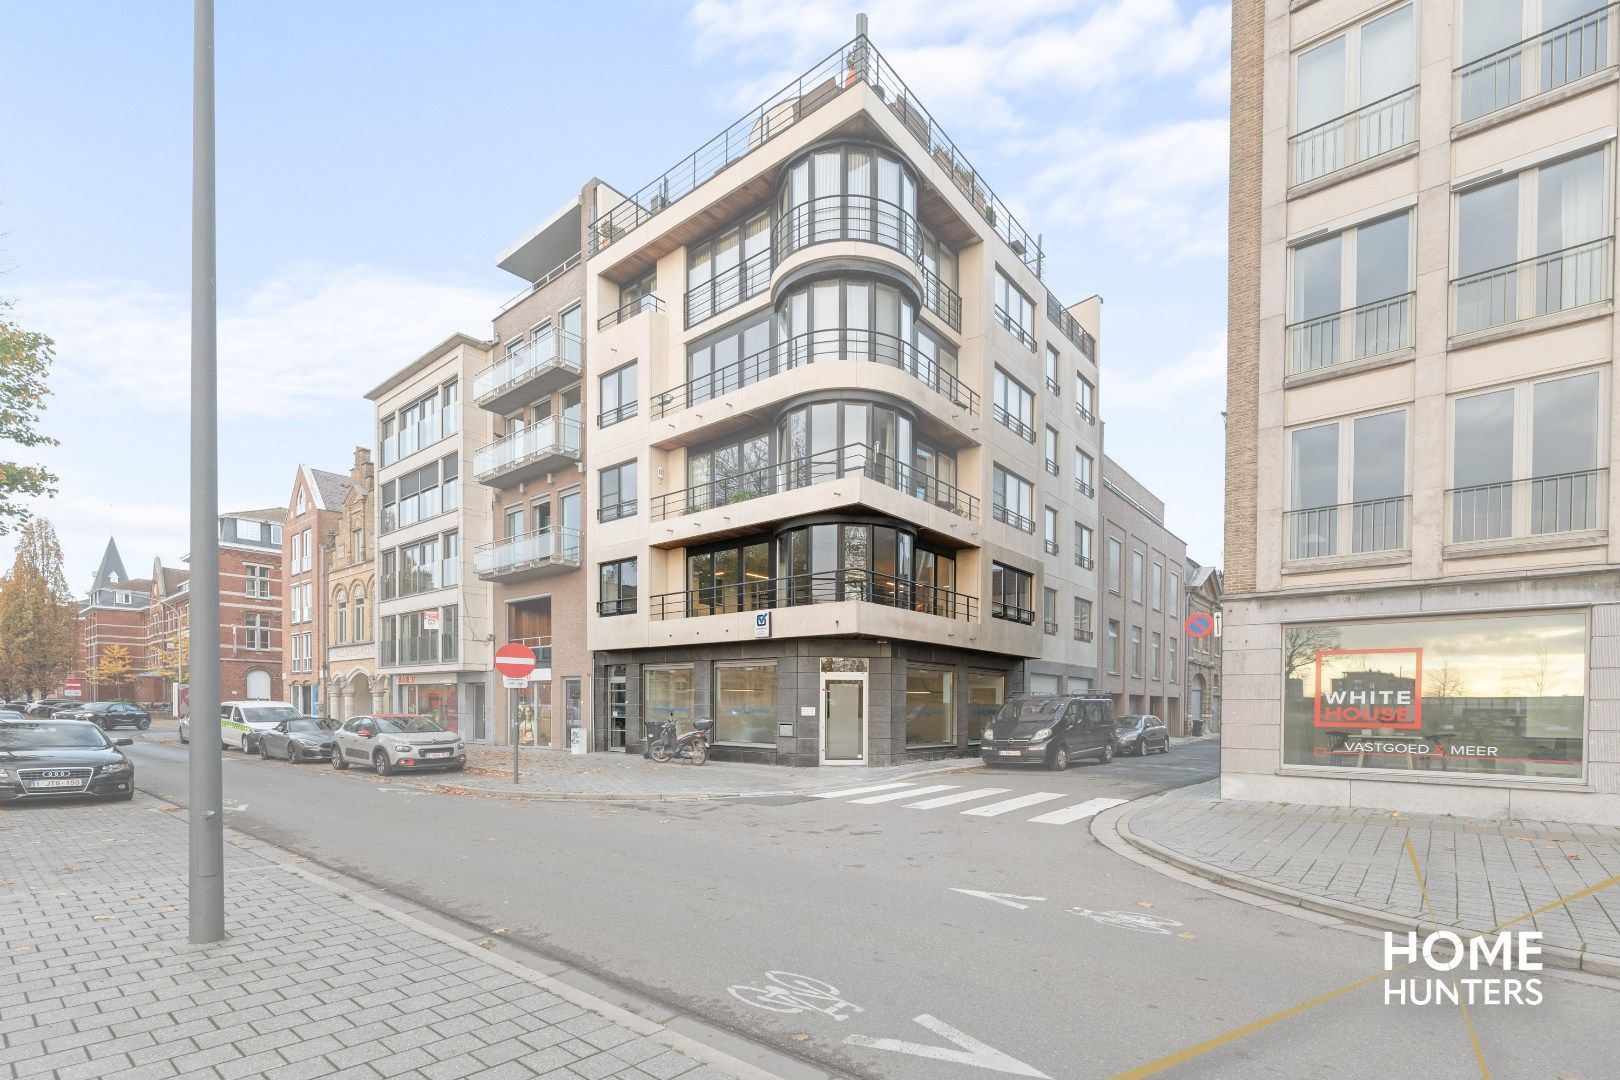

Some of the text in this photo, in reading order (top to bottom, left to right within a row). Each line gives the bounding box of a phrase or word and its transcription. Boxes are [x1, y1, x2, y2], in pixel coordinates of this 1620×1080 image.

[1324, 690, 1411, 705] WHITE
[1325, 706, 1410, 721] HOUSE
[1343, 741, 1498, 757] VASTGOED & MEER
